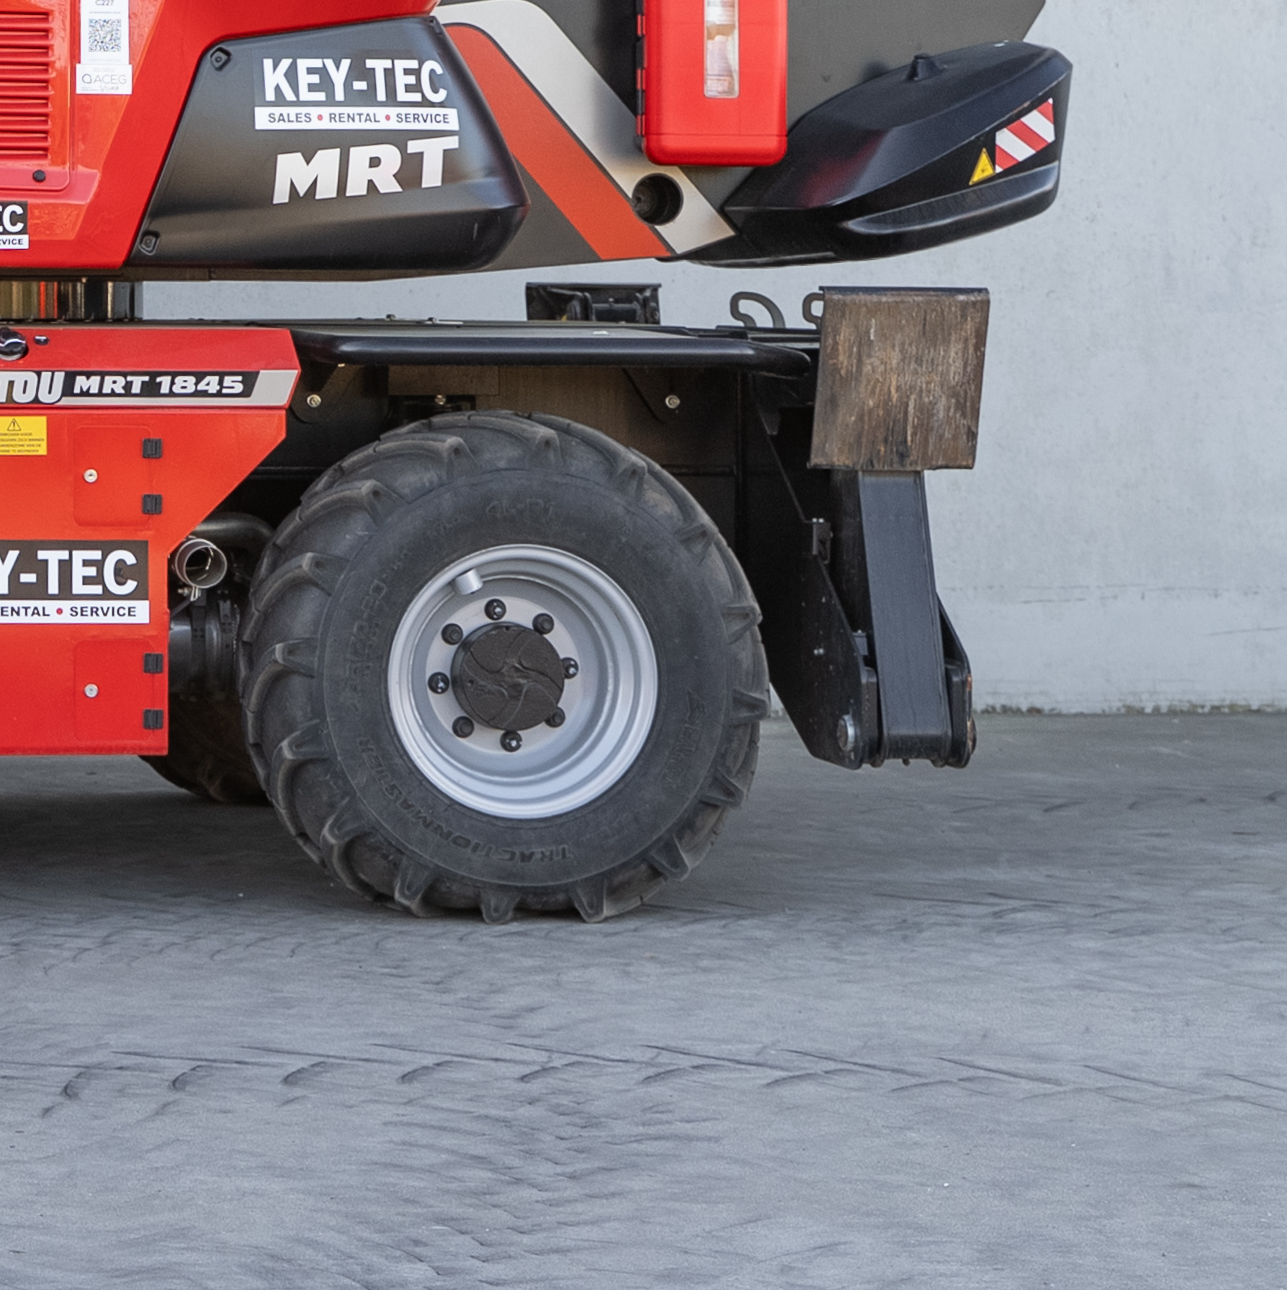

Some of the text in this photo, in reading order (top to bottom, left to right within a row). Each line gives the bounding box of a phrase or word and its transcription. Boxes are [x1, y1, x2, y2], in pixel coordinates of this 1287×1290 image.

[263, 58, 448, 103] KEY-TEC
[268, 112, 450, 124] SALES RENTAL SERVICE
[272, 135, 459, 205] MRT
[73, 376, 151, 394] MRT
[155, 375, 243, 394] 1845
[69, 606, 137, 617] SERVICE
